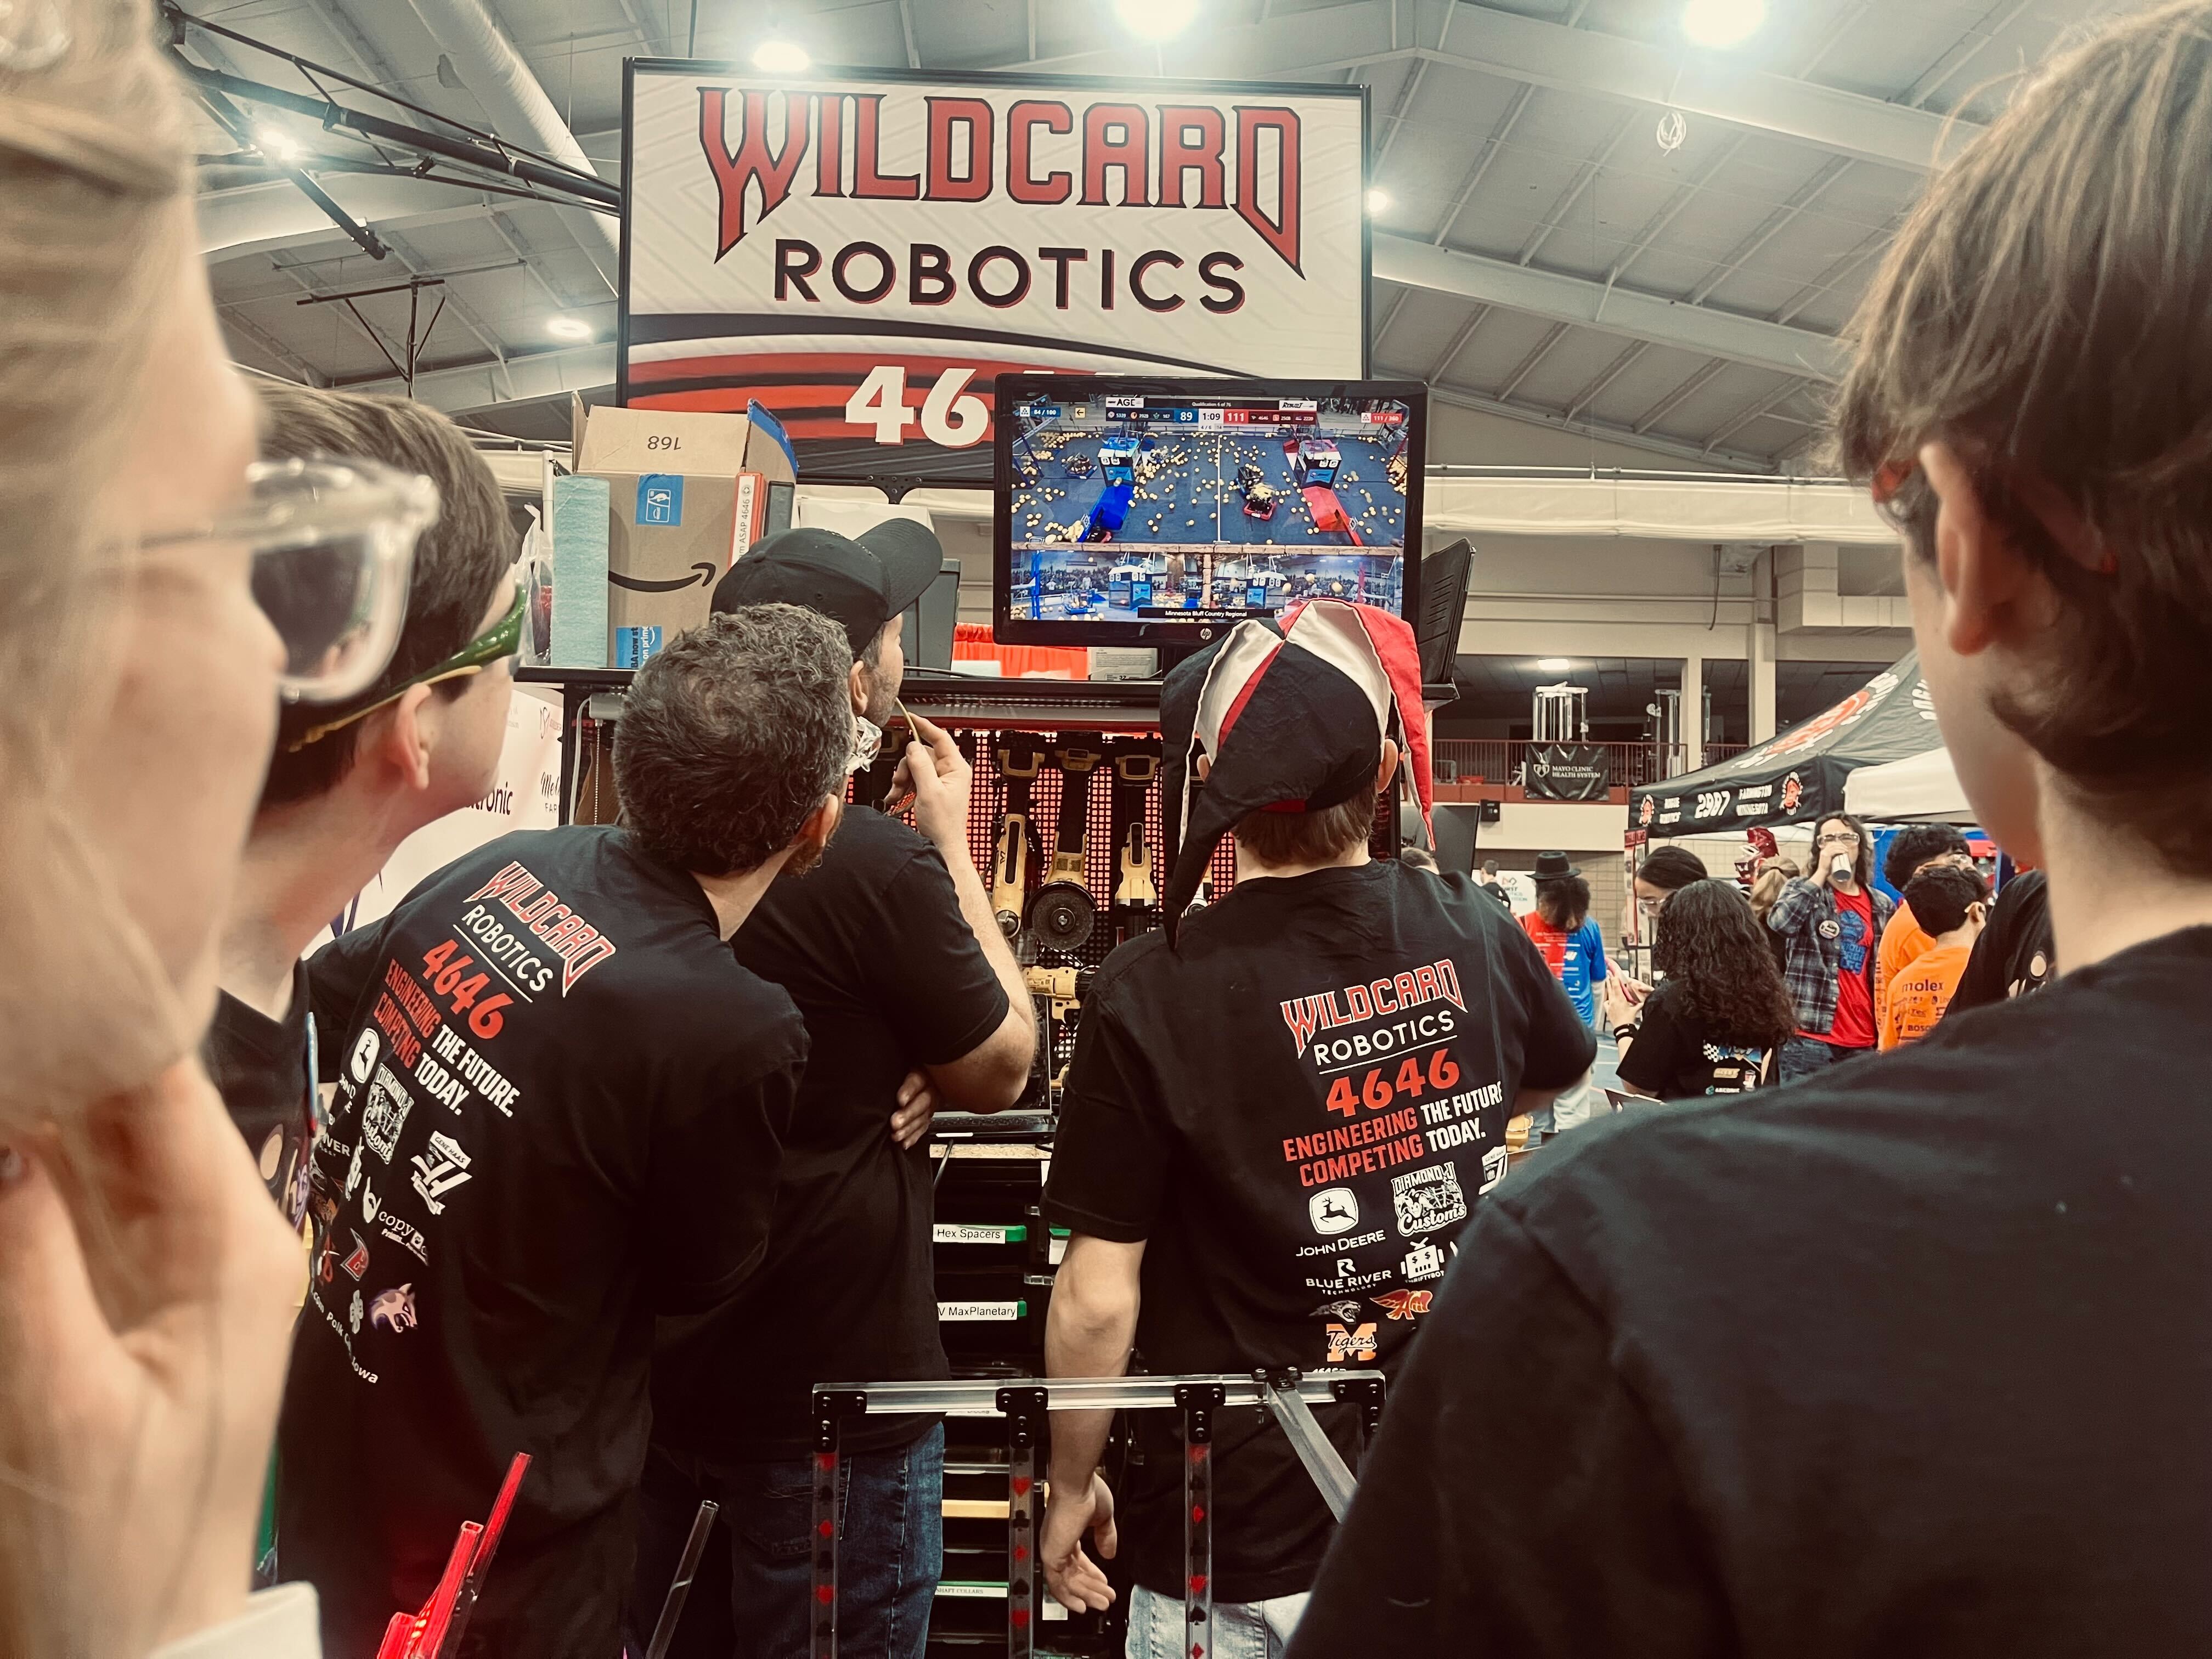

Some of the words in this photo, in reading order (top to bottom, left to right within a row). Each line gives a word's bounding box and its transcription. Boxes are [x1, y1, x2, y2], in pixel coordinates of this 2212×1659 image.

[697, 86, 1306, 280] WILDCARD
[773, 239, 1246, 314] ROBOTICS
[1180, 411, 1193, 421] 89
[1227, 413, 1244, 421] 111
[647, 436, 682, 450] 168
[1201, 628, 1210, 640] hp
[643, 649, 648, 659] on
[1695, 791, 1730, 819] 2987
[463, 860, 616, 998] WILDCARD
[462, 904, 554, 991] ROBOTICS
[422, 939, 514, 1039] 4646
[1902, 979, 1944, 992] molex
[1279, 958, 1468, 1059] WILDCARD
[385, 958, 441, 1038] ENGINEERING
[432, 1024, 466, 1064] THE
[456, 1048, 521, 1118] FUTURE.
[1313, 1010, 1454, 1066] ROBOTICS
[374, 991, 421, 1068] COMPETING
[415, 1052, 470, 1115] TODAY.
[1326, 1048, 1460, 1118] 4646
[1282, 1107, 1417, 1161] ENGINEERING
[1420, 1097, 1452, 1125] THE
[435, 1137, 449, 1151] GENE
[449, 1149, 466, 1163] HAAS
[1300, 1134, 1424, 1187] COMPETING
[1426, 1118, 1486, 1152] TODAY.
[1394, 1166, 1441, 1195] DIAMOND
[379, 1211, 415, 1236] copy
[1399, 1205, 1465, 1234] Customs
[937, 1229, 957, 1238] Hex
[960, 1229, 1001, 1240] Spacers
[1296, 1242, 1336, 1257] JOHN
[1337, 1229, 1386, 1251] DEERE
[1306, 1278, 1344, 1289] BLUE
[1347, 1270, 1392, 1287] RIVER
[1322, 1283, 1376, 1295] TECHNOLOGY
[949, 1307, 1015, 1318] MaxPlanetary
[1327, 1330, 1377, 1353] Tigers
